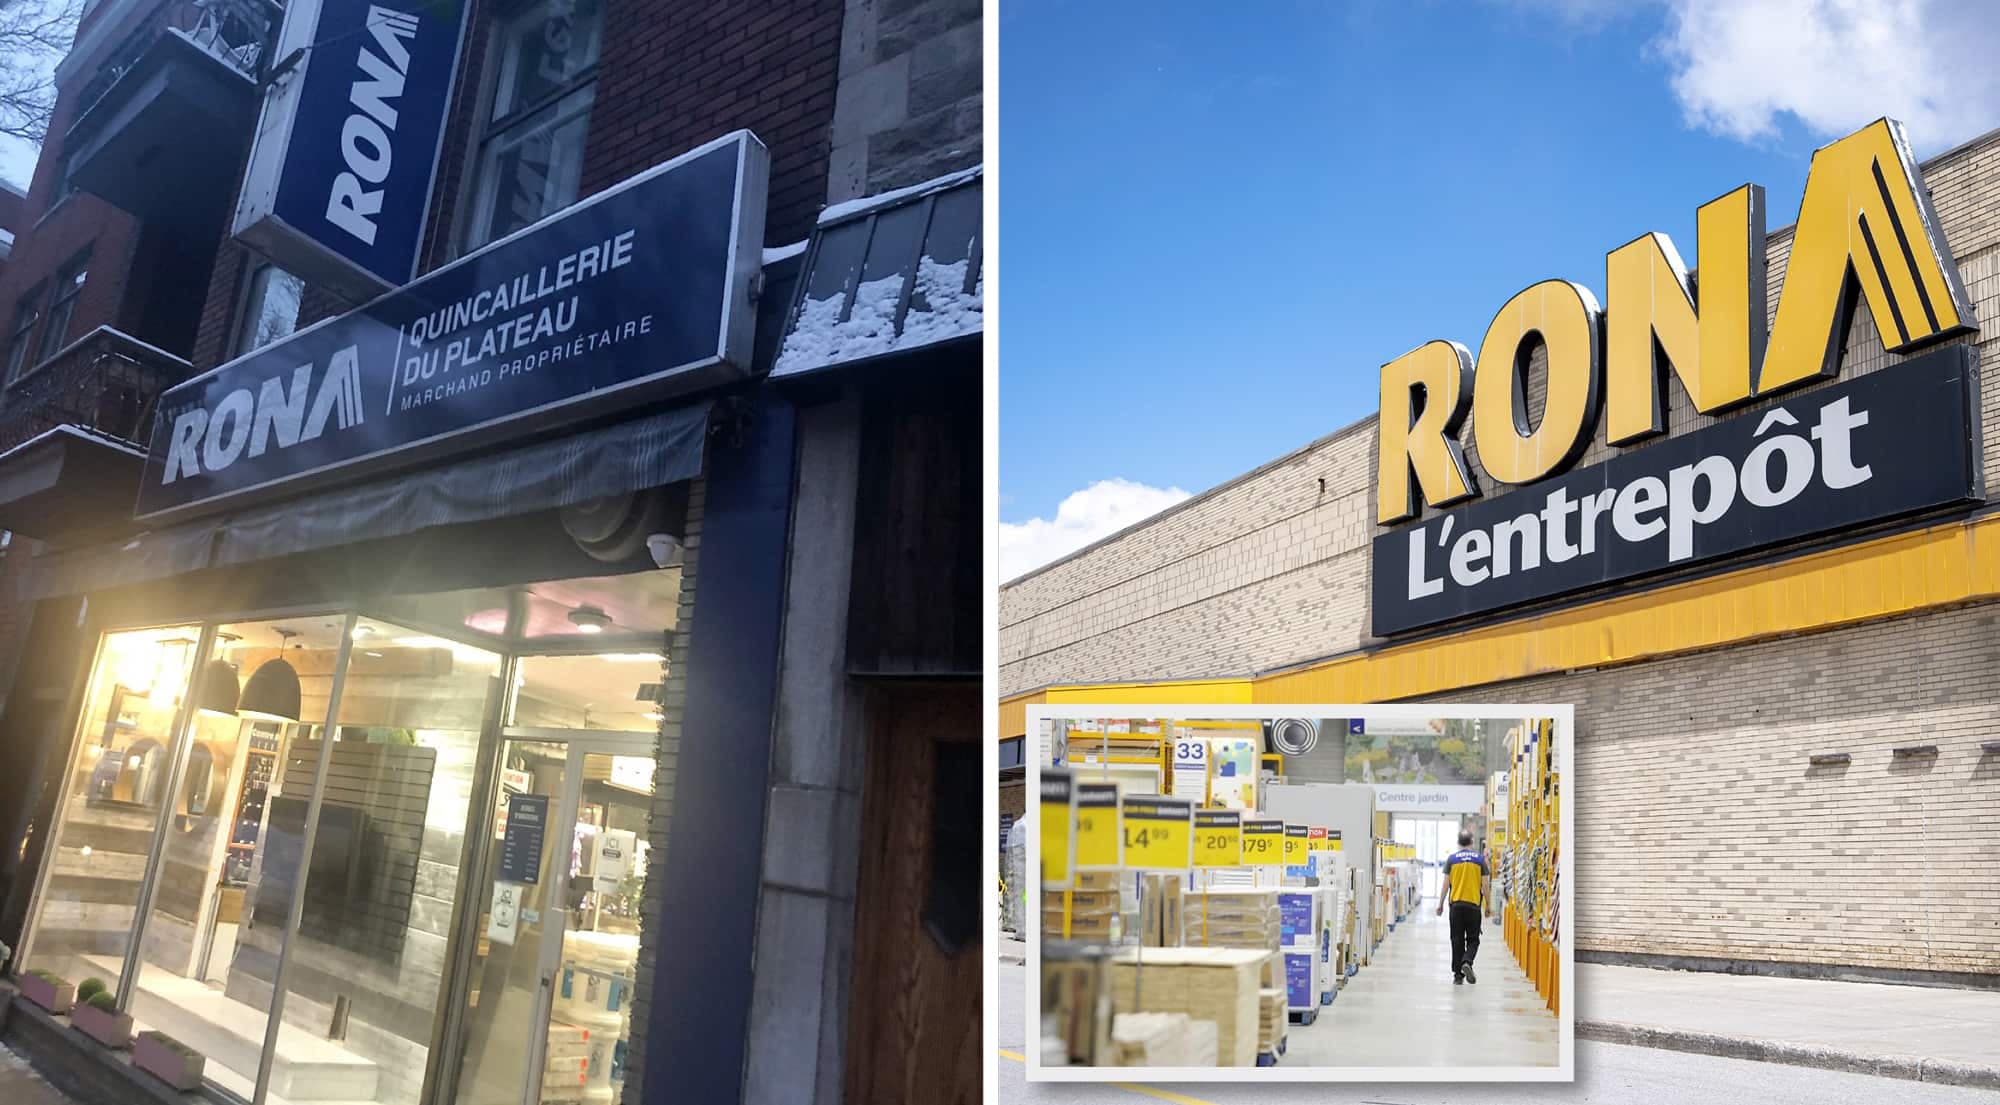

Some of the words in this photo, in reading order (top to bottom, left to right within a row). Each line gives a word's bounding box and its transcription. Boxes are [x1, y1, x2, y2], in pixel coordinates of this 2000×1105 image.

[325, 3, 420, 247] RONA
[402, 350, 441, 387] DU
[443, 296, 579, 369] PLATEAU
[409, 229, 635, 349] QUINCAILLERIE
[1377, 116, 1980, 528] RONA
[162, 343, 364, 486] RONA
[401, 370, 493, 412] MARCHAND
[499, 314, 654, 382] PROPRIÉTAIRE
[1408, 396, 1873, 602] L'entrepôt
[1177, 743, 1204, 760] 33
[1379, 792, 1416, 803] Centre
[1417, 792, 1449, 804] jardin
